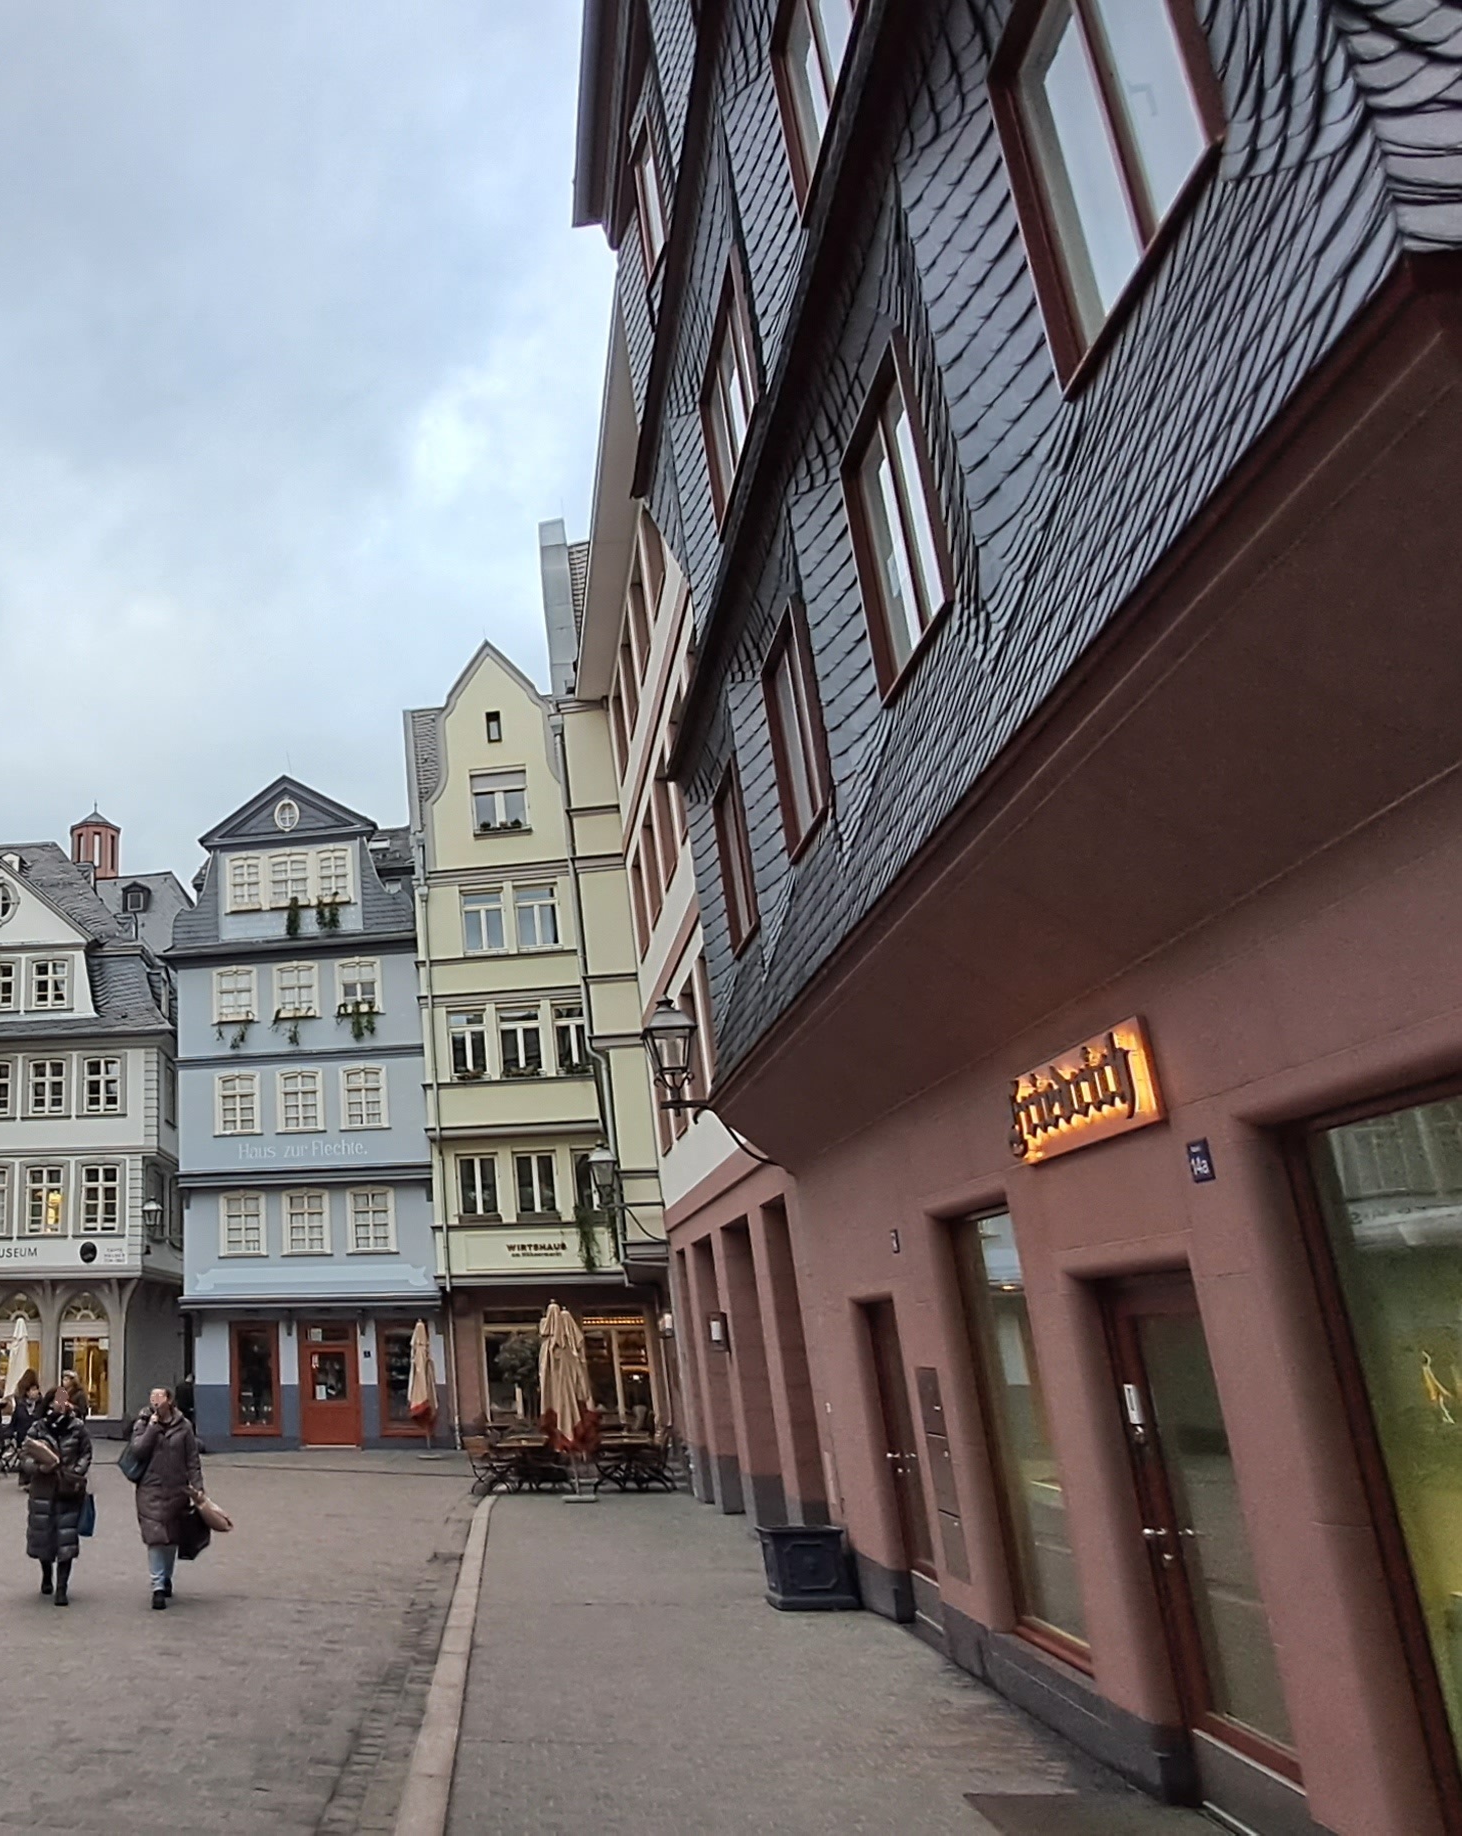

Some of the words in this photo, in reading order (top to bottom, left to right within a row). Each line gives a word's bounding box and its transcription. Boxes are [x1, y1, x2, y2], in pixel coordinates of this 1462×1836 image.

[238, 1143, 276, 1159] Haus
[283, 1145, 308, 1158] zur
[506, 1242, 567, 1252] WIRTSHAUS
